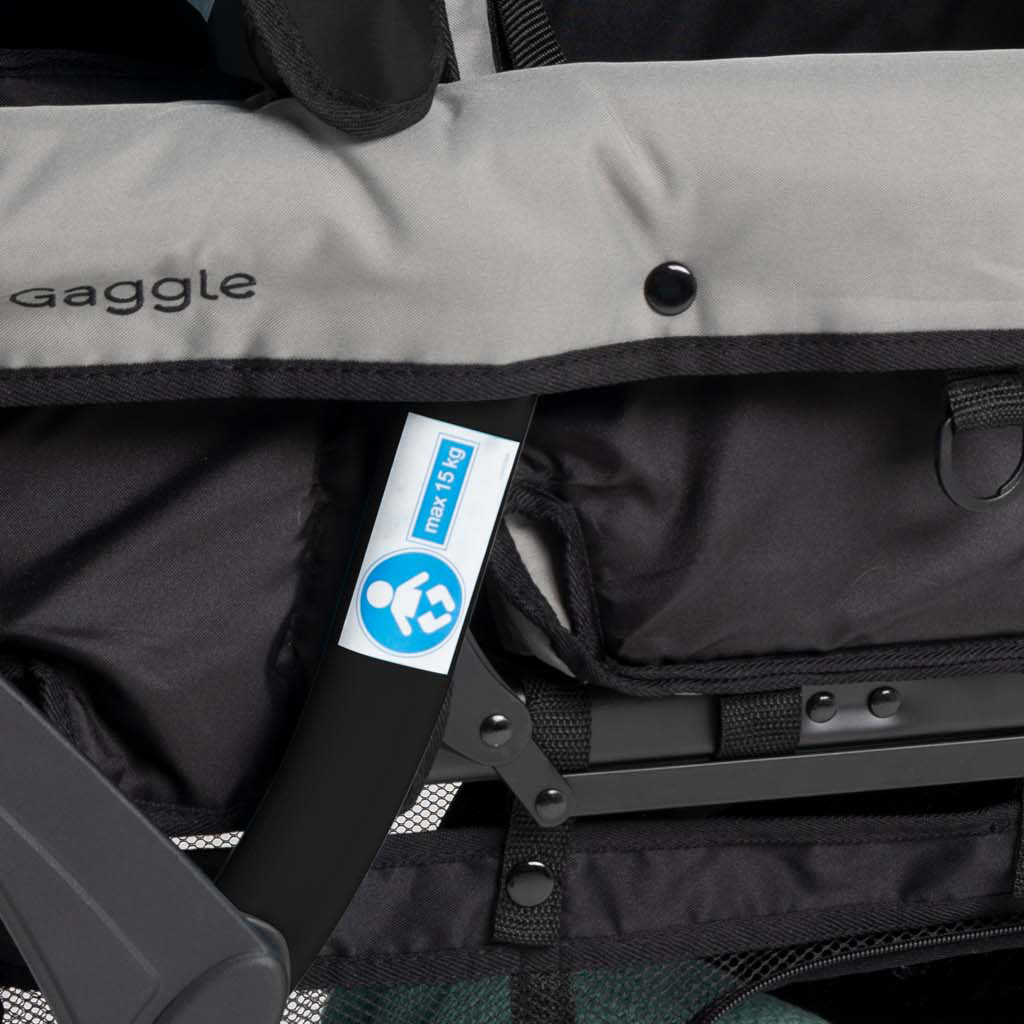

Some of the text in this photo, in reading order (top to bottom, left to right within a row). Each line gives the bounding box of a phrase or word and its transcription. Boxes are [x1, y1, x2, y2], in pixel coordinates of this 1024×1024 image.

[9, 268, 257, 315] Gaggle
[424, 446, 466, 534] max 15 kg
